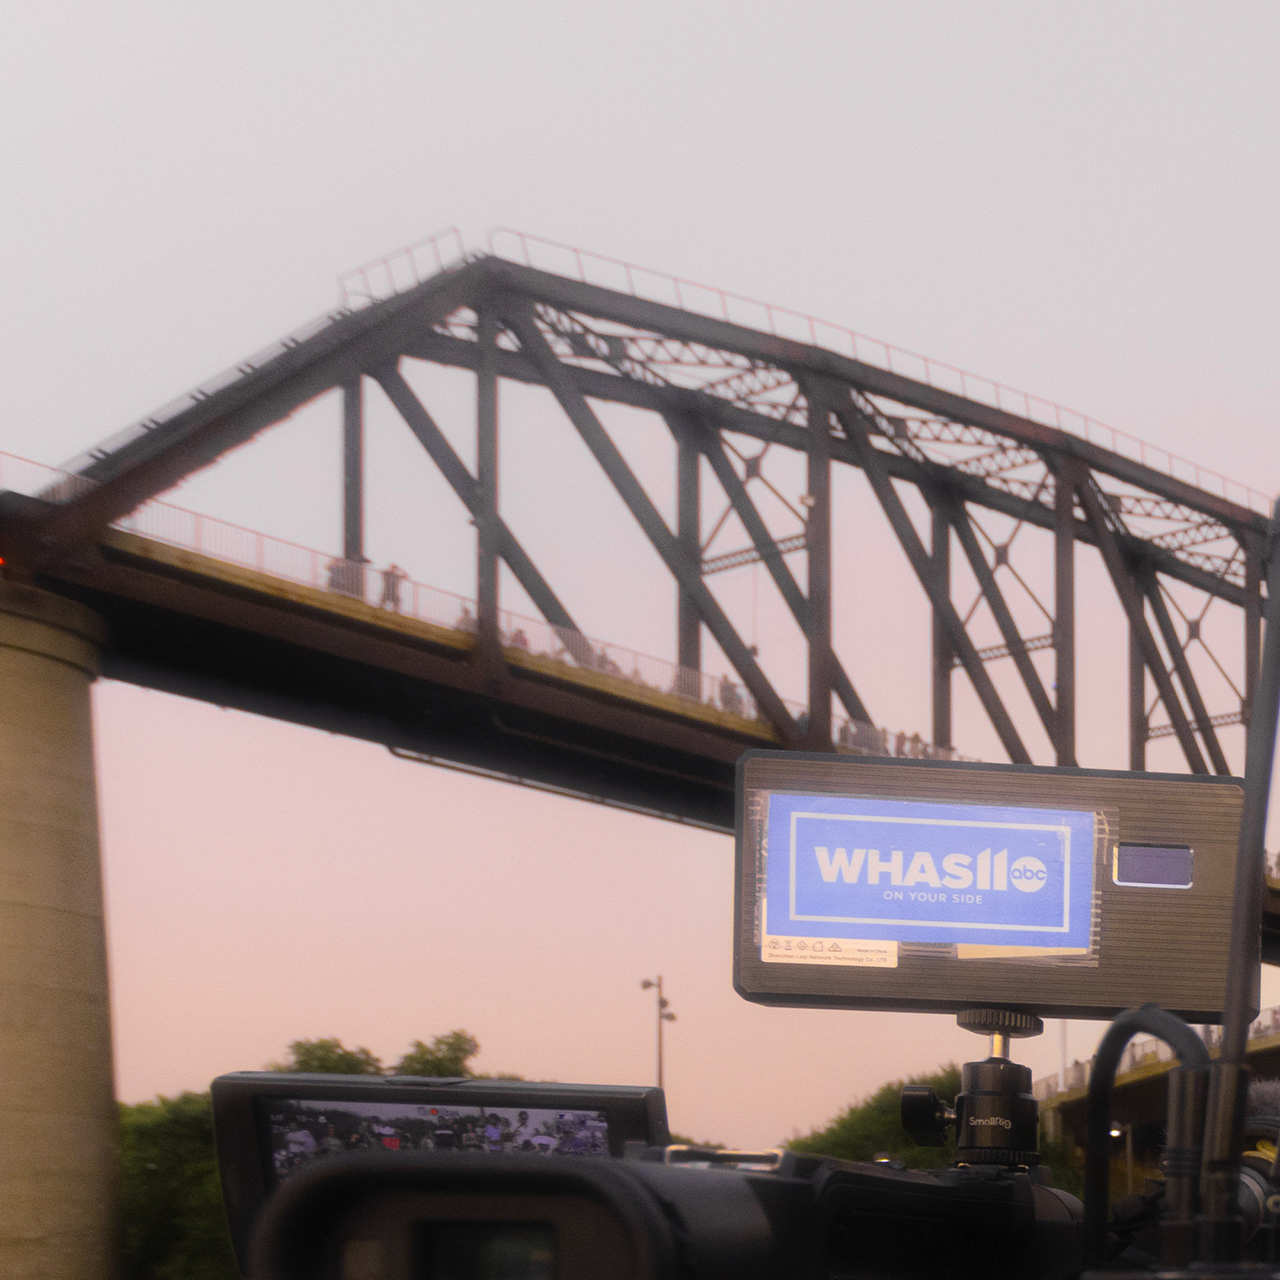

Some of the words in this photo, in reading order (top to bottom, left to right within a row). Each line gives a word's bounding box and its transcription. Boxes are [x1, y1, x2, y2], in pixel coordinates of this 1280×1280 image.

[1011, 865, 1047, 882] abc
[883, 890, 904, 901] ON
[909, 891, 947, 903] YOUR
[952, 893, 983, 905] SIDE
[833, 955, 864, 963] Technology
[969, 1116, 1012, 1130] SmallRig
